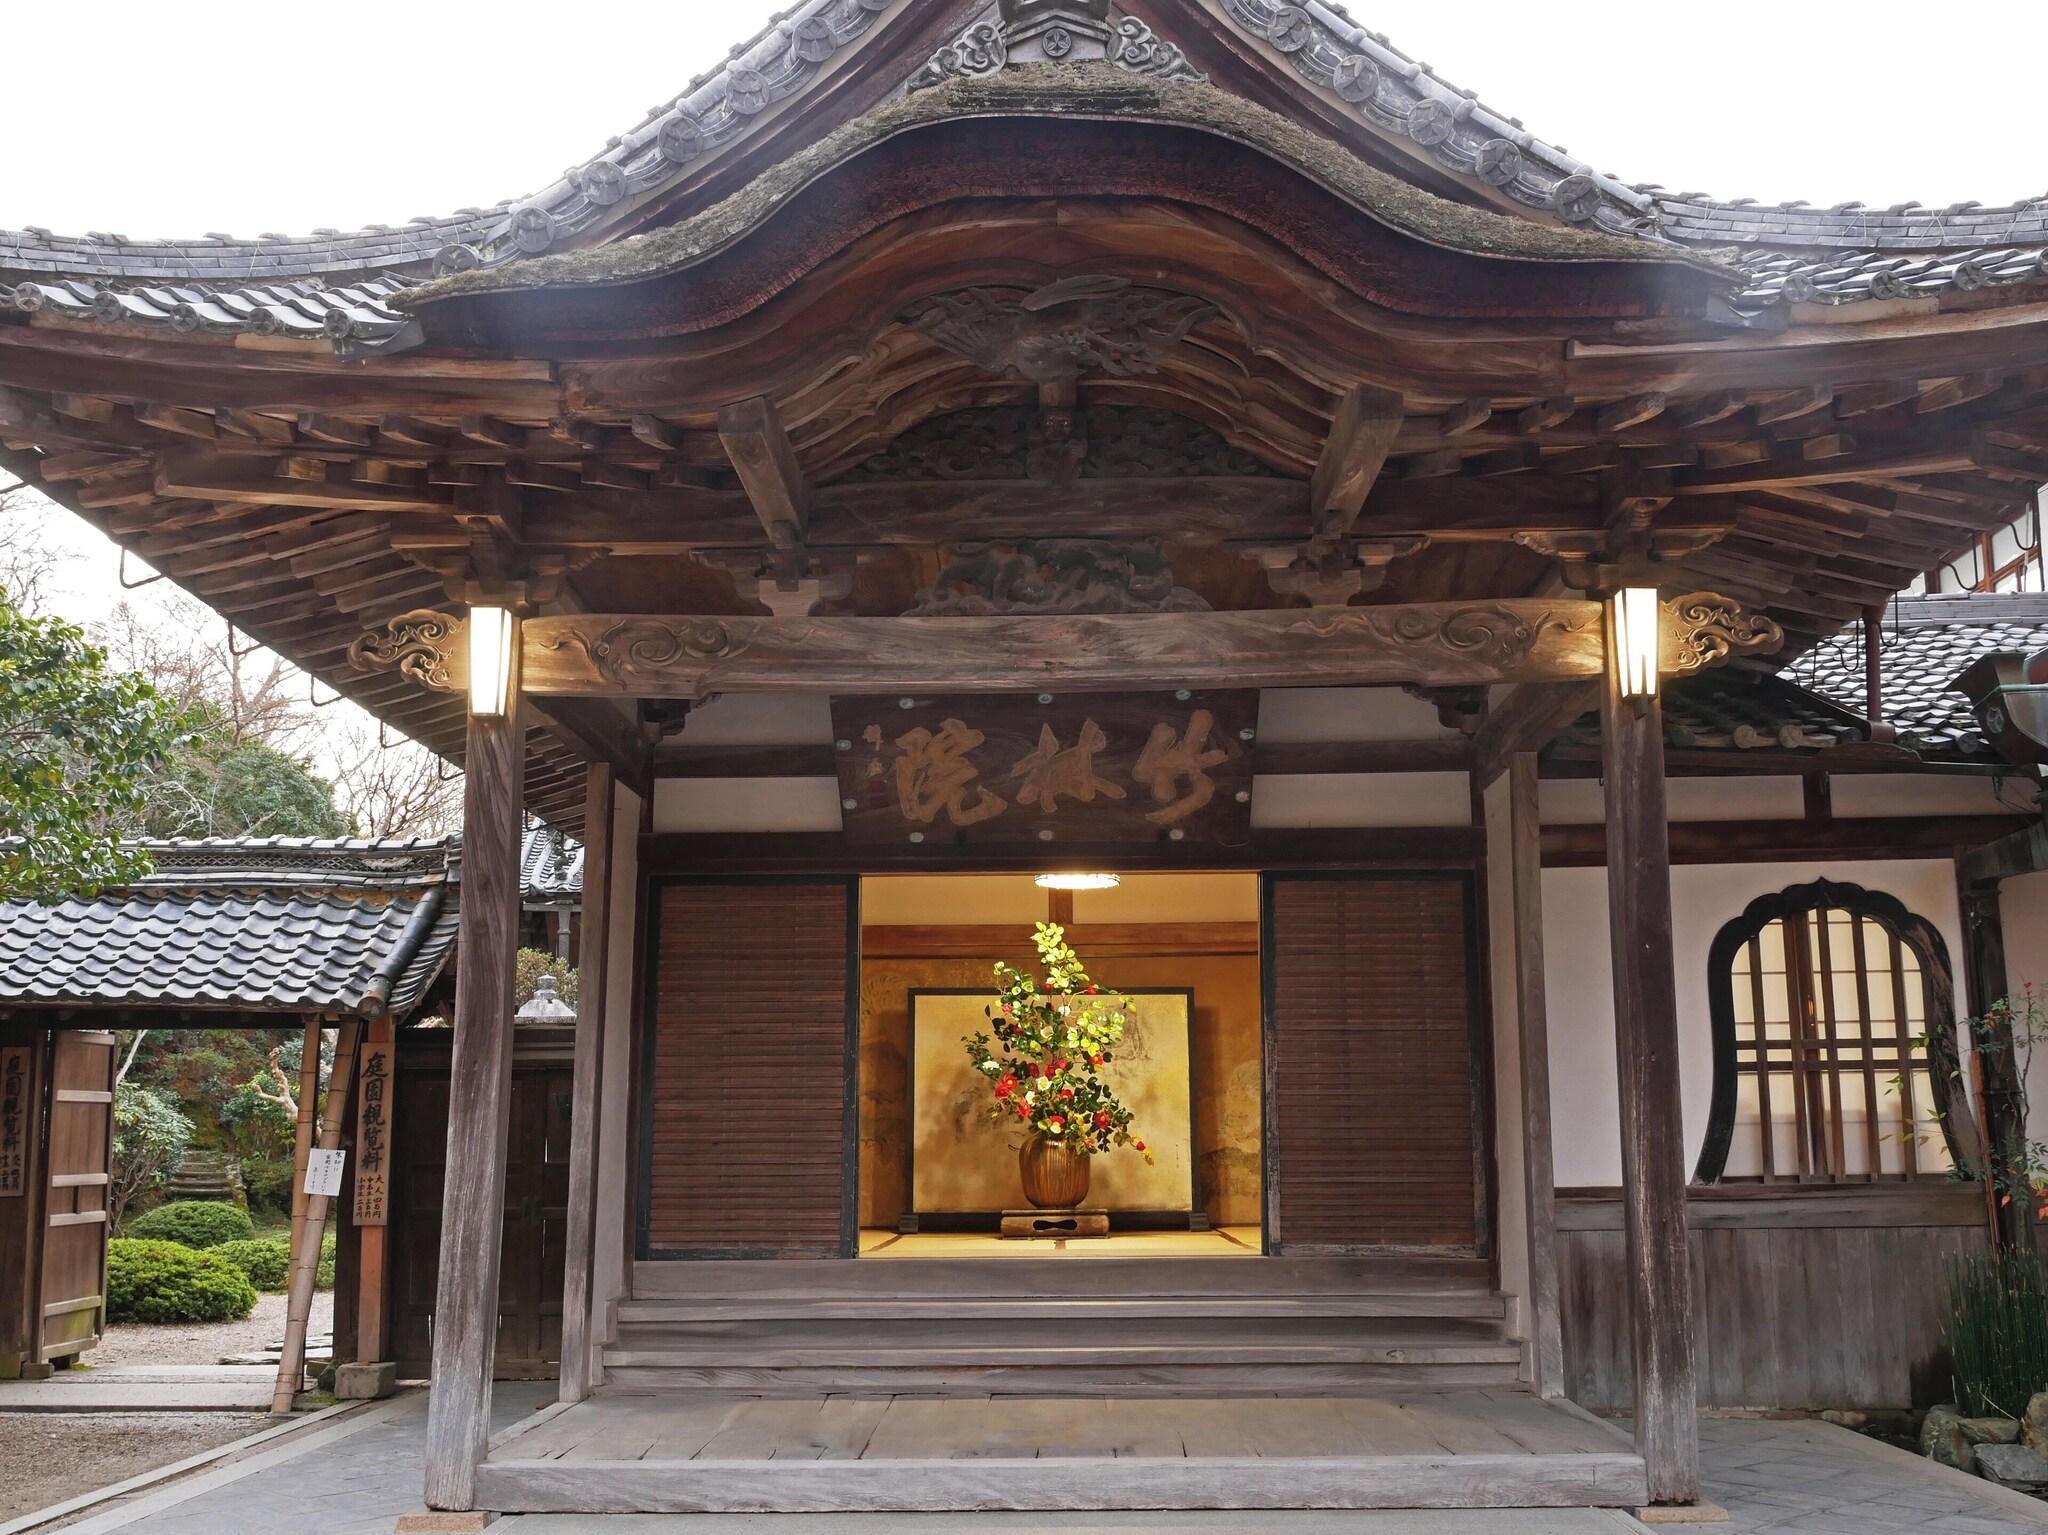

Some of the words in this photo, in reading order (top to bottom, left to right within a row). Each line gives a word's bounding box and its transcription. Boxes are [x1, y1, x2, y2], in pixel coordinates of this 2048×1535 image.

[361, 1052, 388, 1173] 庭園観覧料
